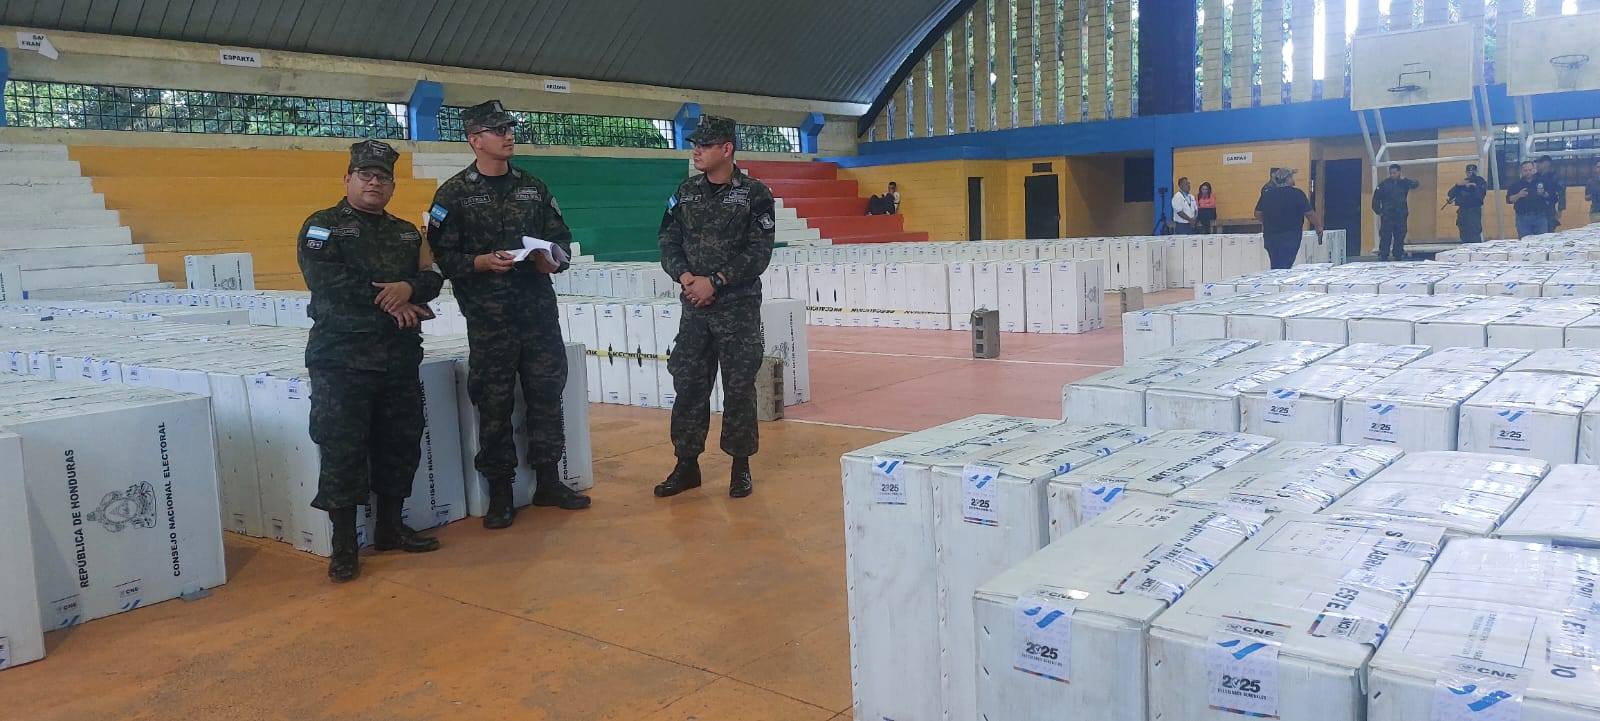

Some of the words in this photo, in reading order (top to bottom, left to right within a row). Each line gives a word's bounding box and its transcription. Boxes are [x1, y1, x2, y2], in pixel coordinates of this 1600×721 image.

[158, 421, 170, 478] ELECTORAL
[64, 449, 80, 509] HONDURAS
[164, 481, 176, 530] NACIONAL
[970, 498, 990, 509] 2025
[72, 511, 82, 526] DE
[74, 528, 89, 588] REPÚBLICA
[169, 532, 181, 577] CONSEJO
[1326, 587, 1359, 611] ESTE
[1242, 625, 1275, 637] CNE
[1026, 641, 1058, 660] 2025
[1222, 674, 1261, 693] 2025
[1477, 667, 1518, 680] CNE
